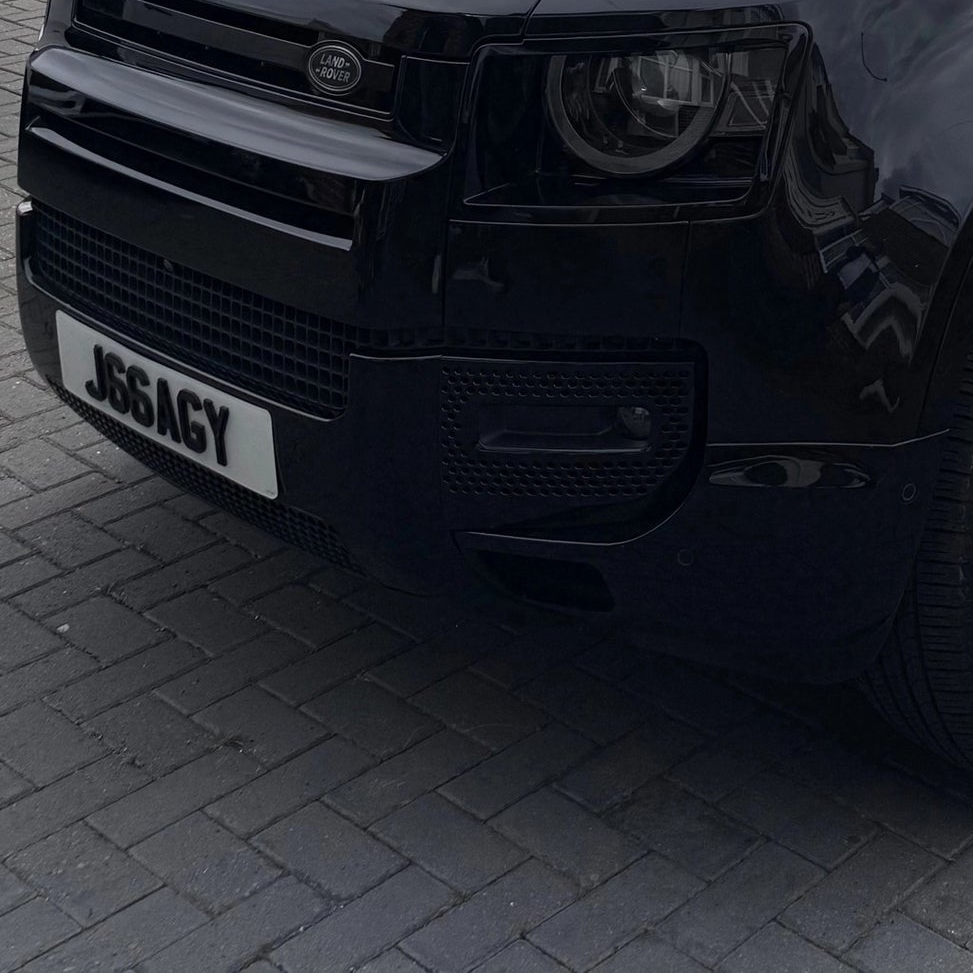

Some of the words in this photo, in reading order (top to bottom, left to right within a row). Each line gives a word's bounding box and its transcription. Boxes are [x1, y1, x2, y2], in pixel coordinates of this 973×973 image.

[319, 53, 345, 68] LAND
[319, 66, 351, 82] ROVER
[85, 343, 230, 467] J66AGY
